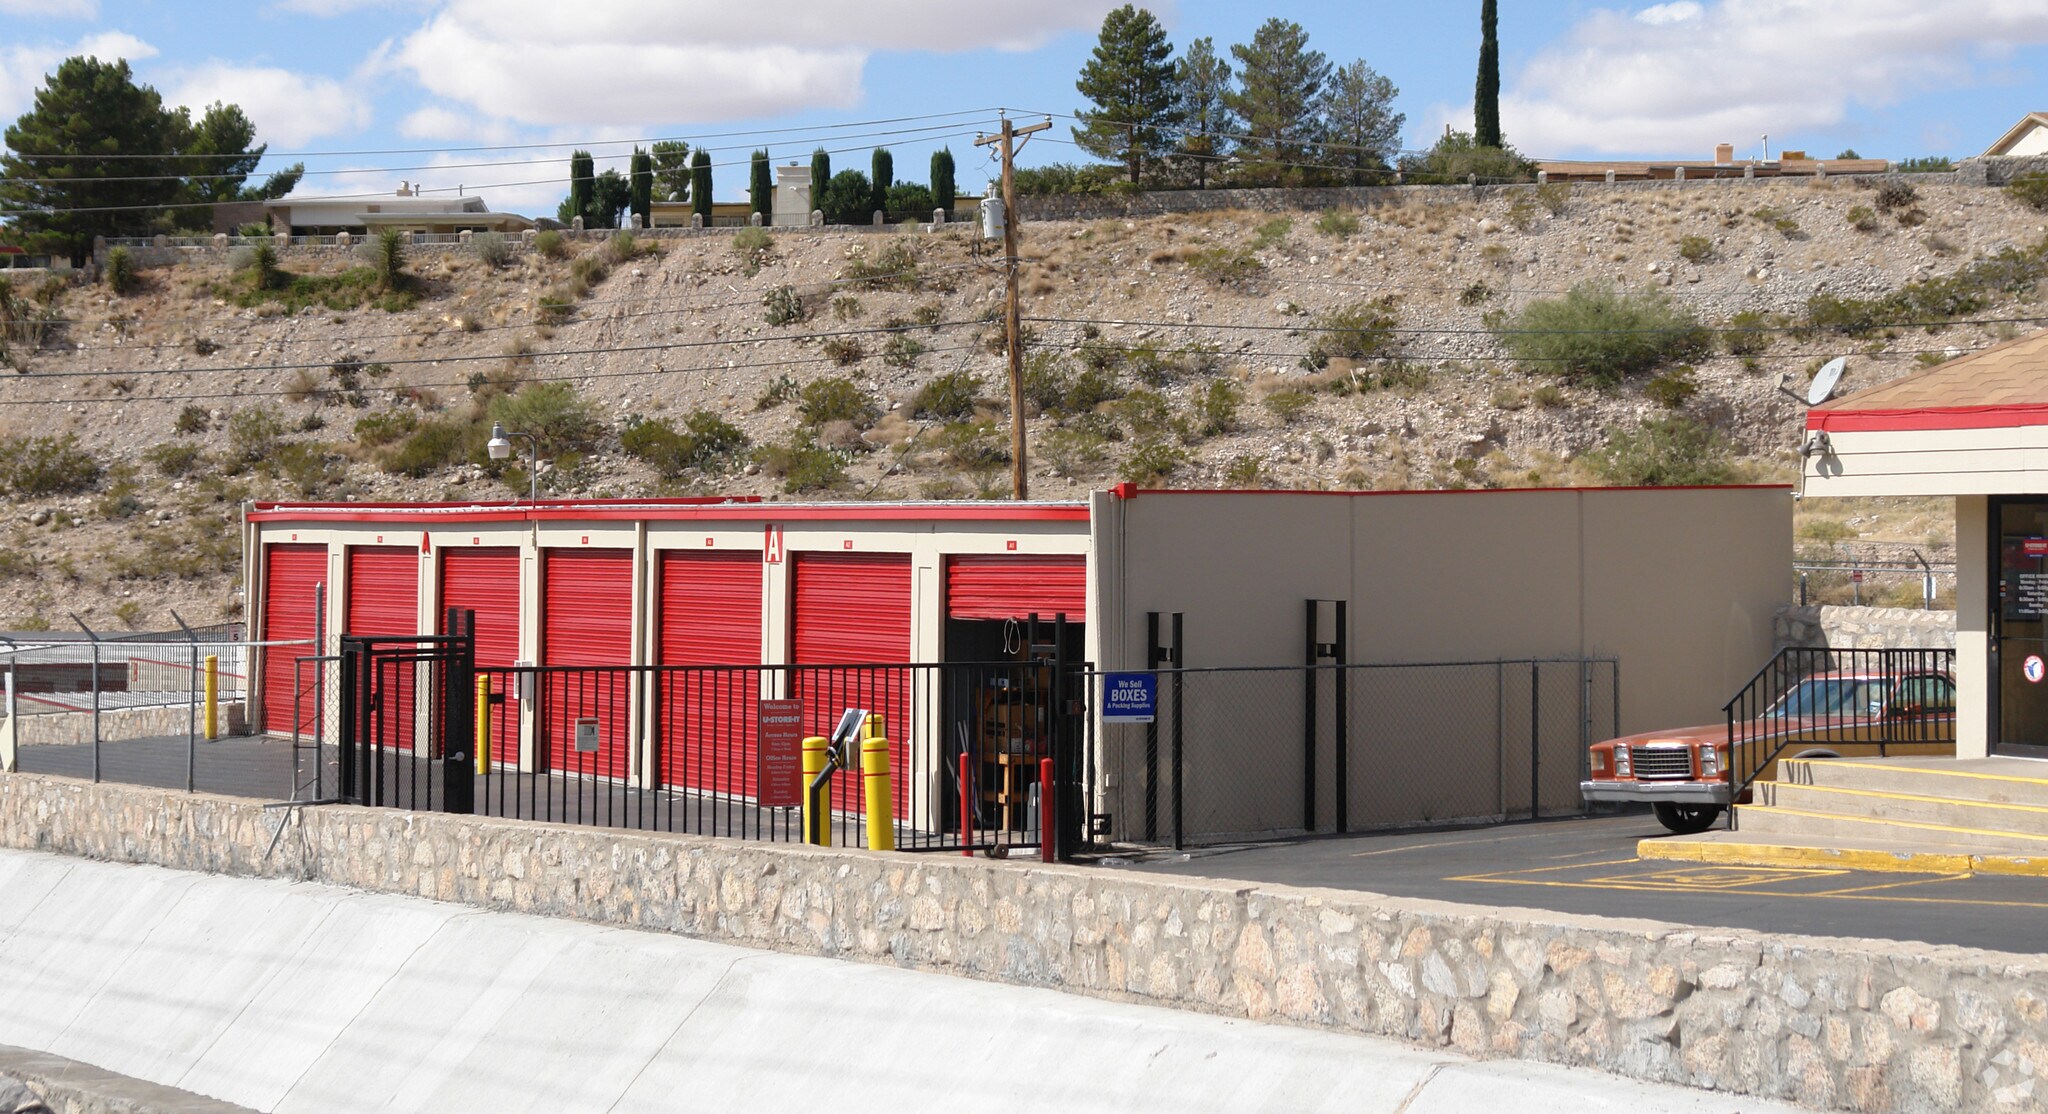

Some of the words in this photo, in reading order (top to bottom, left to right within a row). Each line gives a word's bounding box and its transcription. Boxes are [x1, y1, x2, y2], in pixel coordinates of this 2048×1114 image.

[767, 525, 780, 561] A
[1118, 680, 1128, 688] We
[1129, 680, 1142, 688] Sell
[1111, 689, 1147, 702] BOXES
